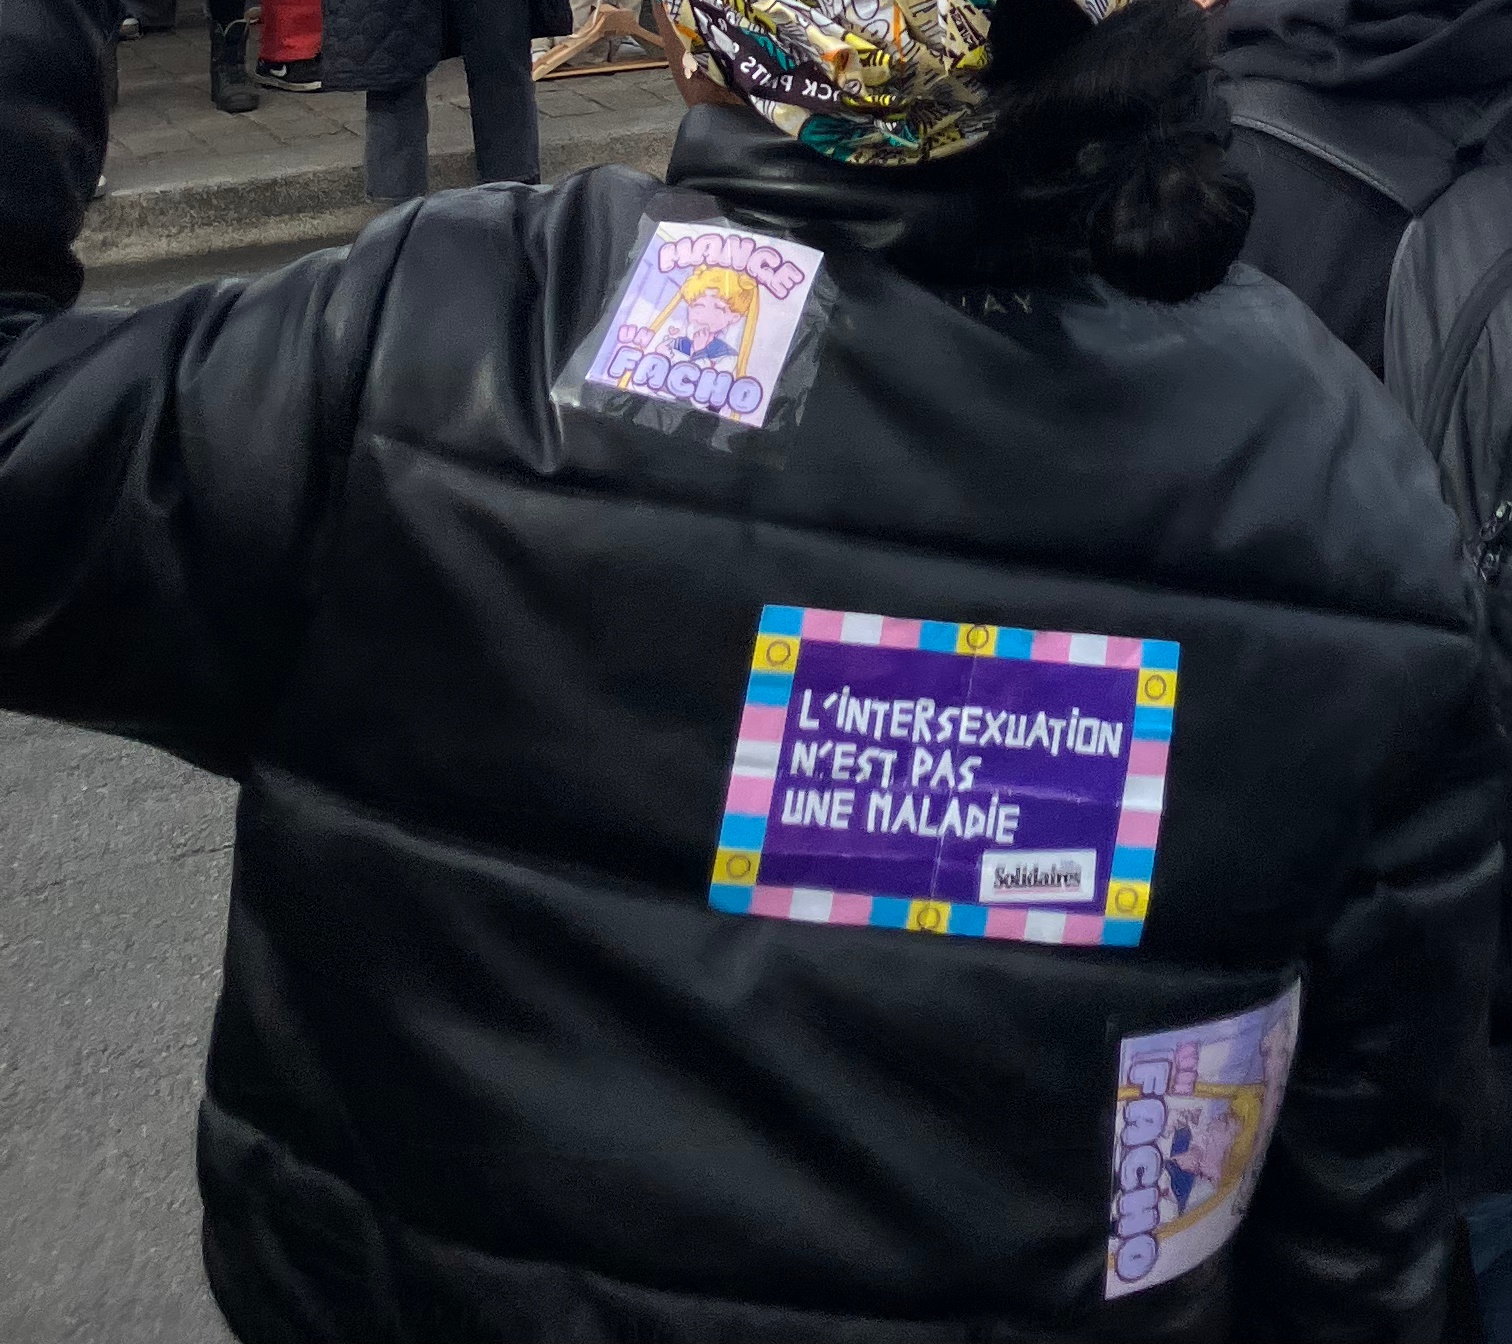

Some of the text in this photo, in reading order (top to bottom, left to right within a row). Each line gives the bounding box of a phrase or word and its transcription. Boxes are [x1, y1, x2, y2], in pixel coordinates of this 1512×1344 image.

[658, 233, 805, 301] MANGE
[617, 324, 656, 347] UN
[607, 345, 764, 414] FACHO
[912, 748, 983, 792] PAS
[781, 787, 1021, 846] UNE MALADIE
